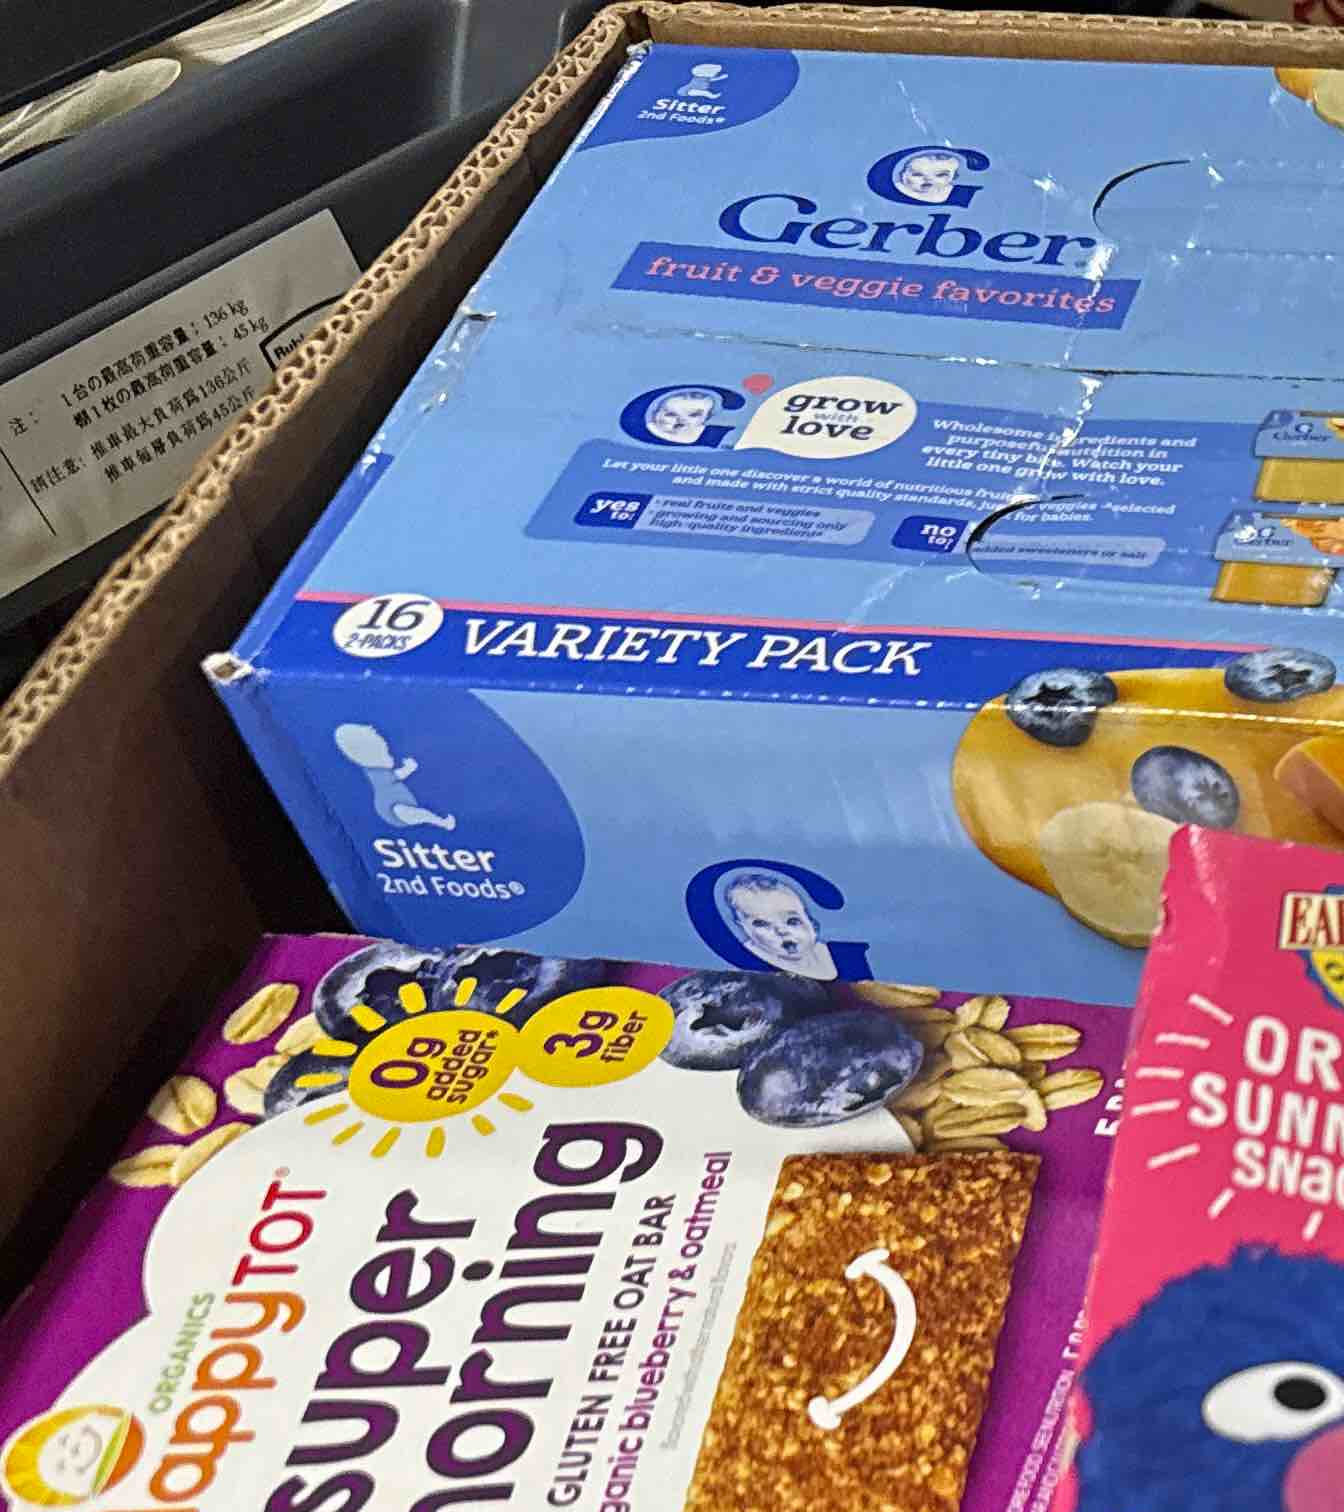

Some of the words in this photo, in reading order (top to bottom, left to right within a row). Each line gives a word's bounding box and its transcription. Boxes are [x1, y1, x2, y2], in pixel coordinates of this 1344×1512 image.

[653, 98, 725, 116] Sitter
[718, 193, 1097, 267] Gerber
[646, 256, 741, 283] fruit
[750, 265, 780, 286] &
[791, 272, 921, 301] veggie
[931, 279, 1116, 315] favorites
[782, 391, 903, 419] grow
[781, 415, 874, 442] love
[933, 419, 1043, 440] Wholesome
[1160, 437, 1197, 448] and
[921, 445, 974, 461] every
[978, 449, 1021, 465] tiny
[1071, 457, 1133, 473] Watch
[1133, 462, 1183, 475] your
[925, 456, 973, 470] little
[976, 462, 1011, 474] one
[1071, 470, 1115, 484] with
[591, 498, 641, 513] yes
[356, 599, 429, 632] 16
[464, 618, 745, 668] VARIETY
[747, 633, 933, 677] PACK
[373, 838, 495, 873] Sitter
[382, 875, 429, 896] 2nd
[543, 1010, 618, 1059] 3g
[603, 1011, 648, 1063] fiber
[371, 1035, 444, 1089] 0g
[427, 1030, 481, 1099] added
[681, 1151, 733, 1260] oatmeal
[668, 1261, 696, 1284] &
[149, 1292, 214, 1415] ORGANICS
[547, 1394, 611, 1507] GLUTEN
[591, 1317, 630, 1392] FREE
[613, 1248, 657, 1317] OAT
[639, 1193, 676, 1251] BAR
[621, 1283, 692, 1434] blueberry
